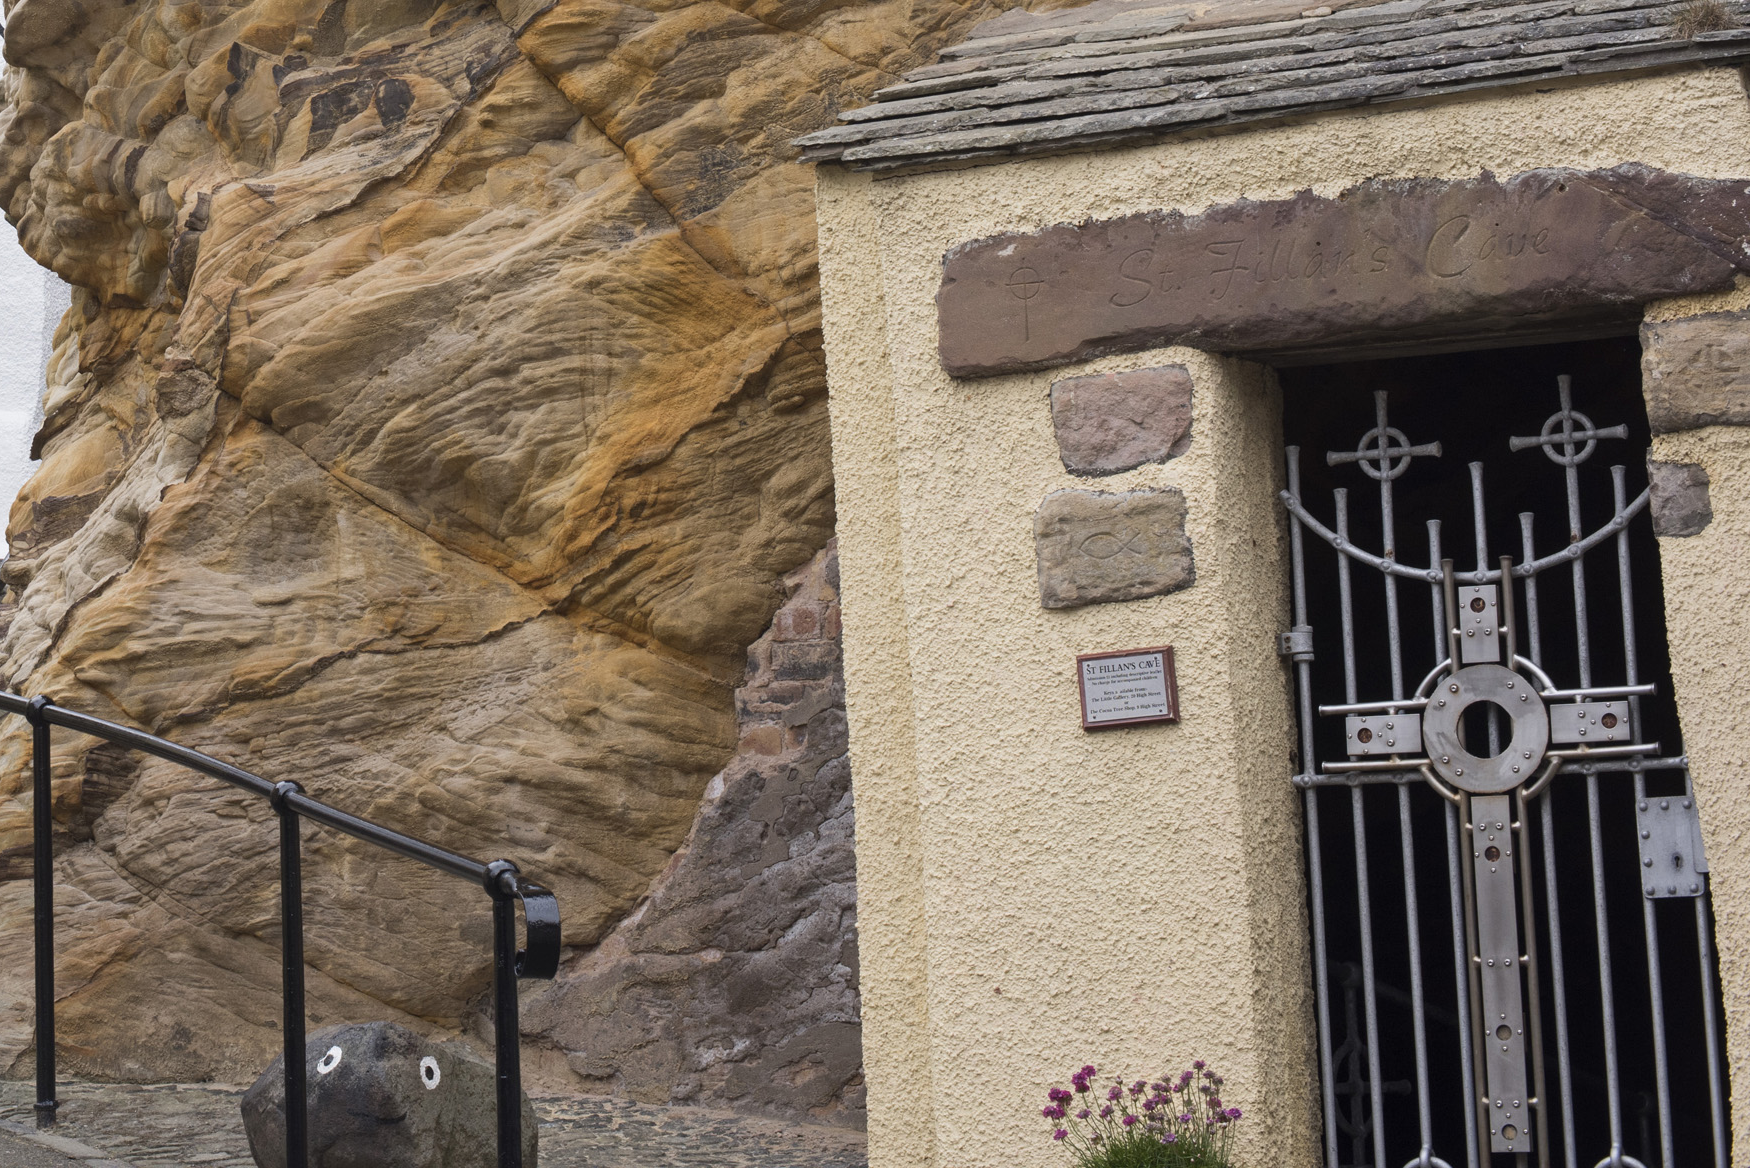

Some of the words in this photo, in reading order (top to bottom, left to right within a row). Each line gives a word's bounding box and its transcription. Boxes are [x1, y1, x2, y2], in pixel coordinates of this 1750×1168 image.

[1426, 215, 1550, 279] Cave
[1086, 666, 1096, 675] ST
[1100, 662, 1136, 673] FILLAN'S
[1139, 660, 1160, 669] CAVE
